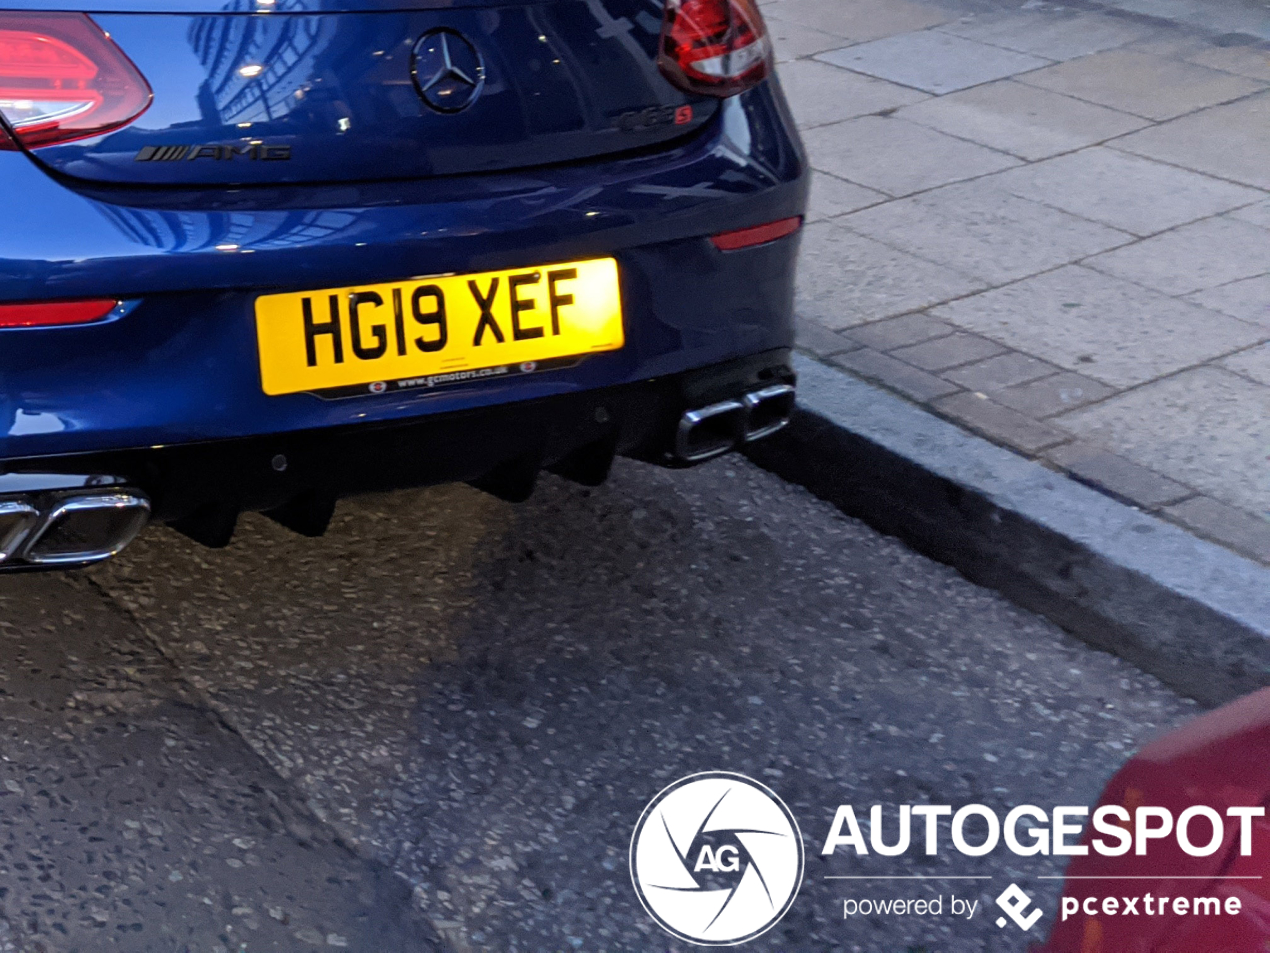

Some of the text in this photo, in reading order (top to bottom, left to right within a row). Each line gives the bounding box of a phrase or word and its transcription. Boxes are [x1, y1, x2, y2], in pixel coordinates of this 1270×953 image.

[187, 145, 291, 161] AMG
[301, 268, 577, 367] HG19 XEF
[397, 366, 508, 387] www.gcmotors.co.uk
